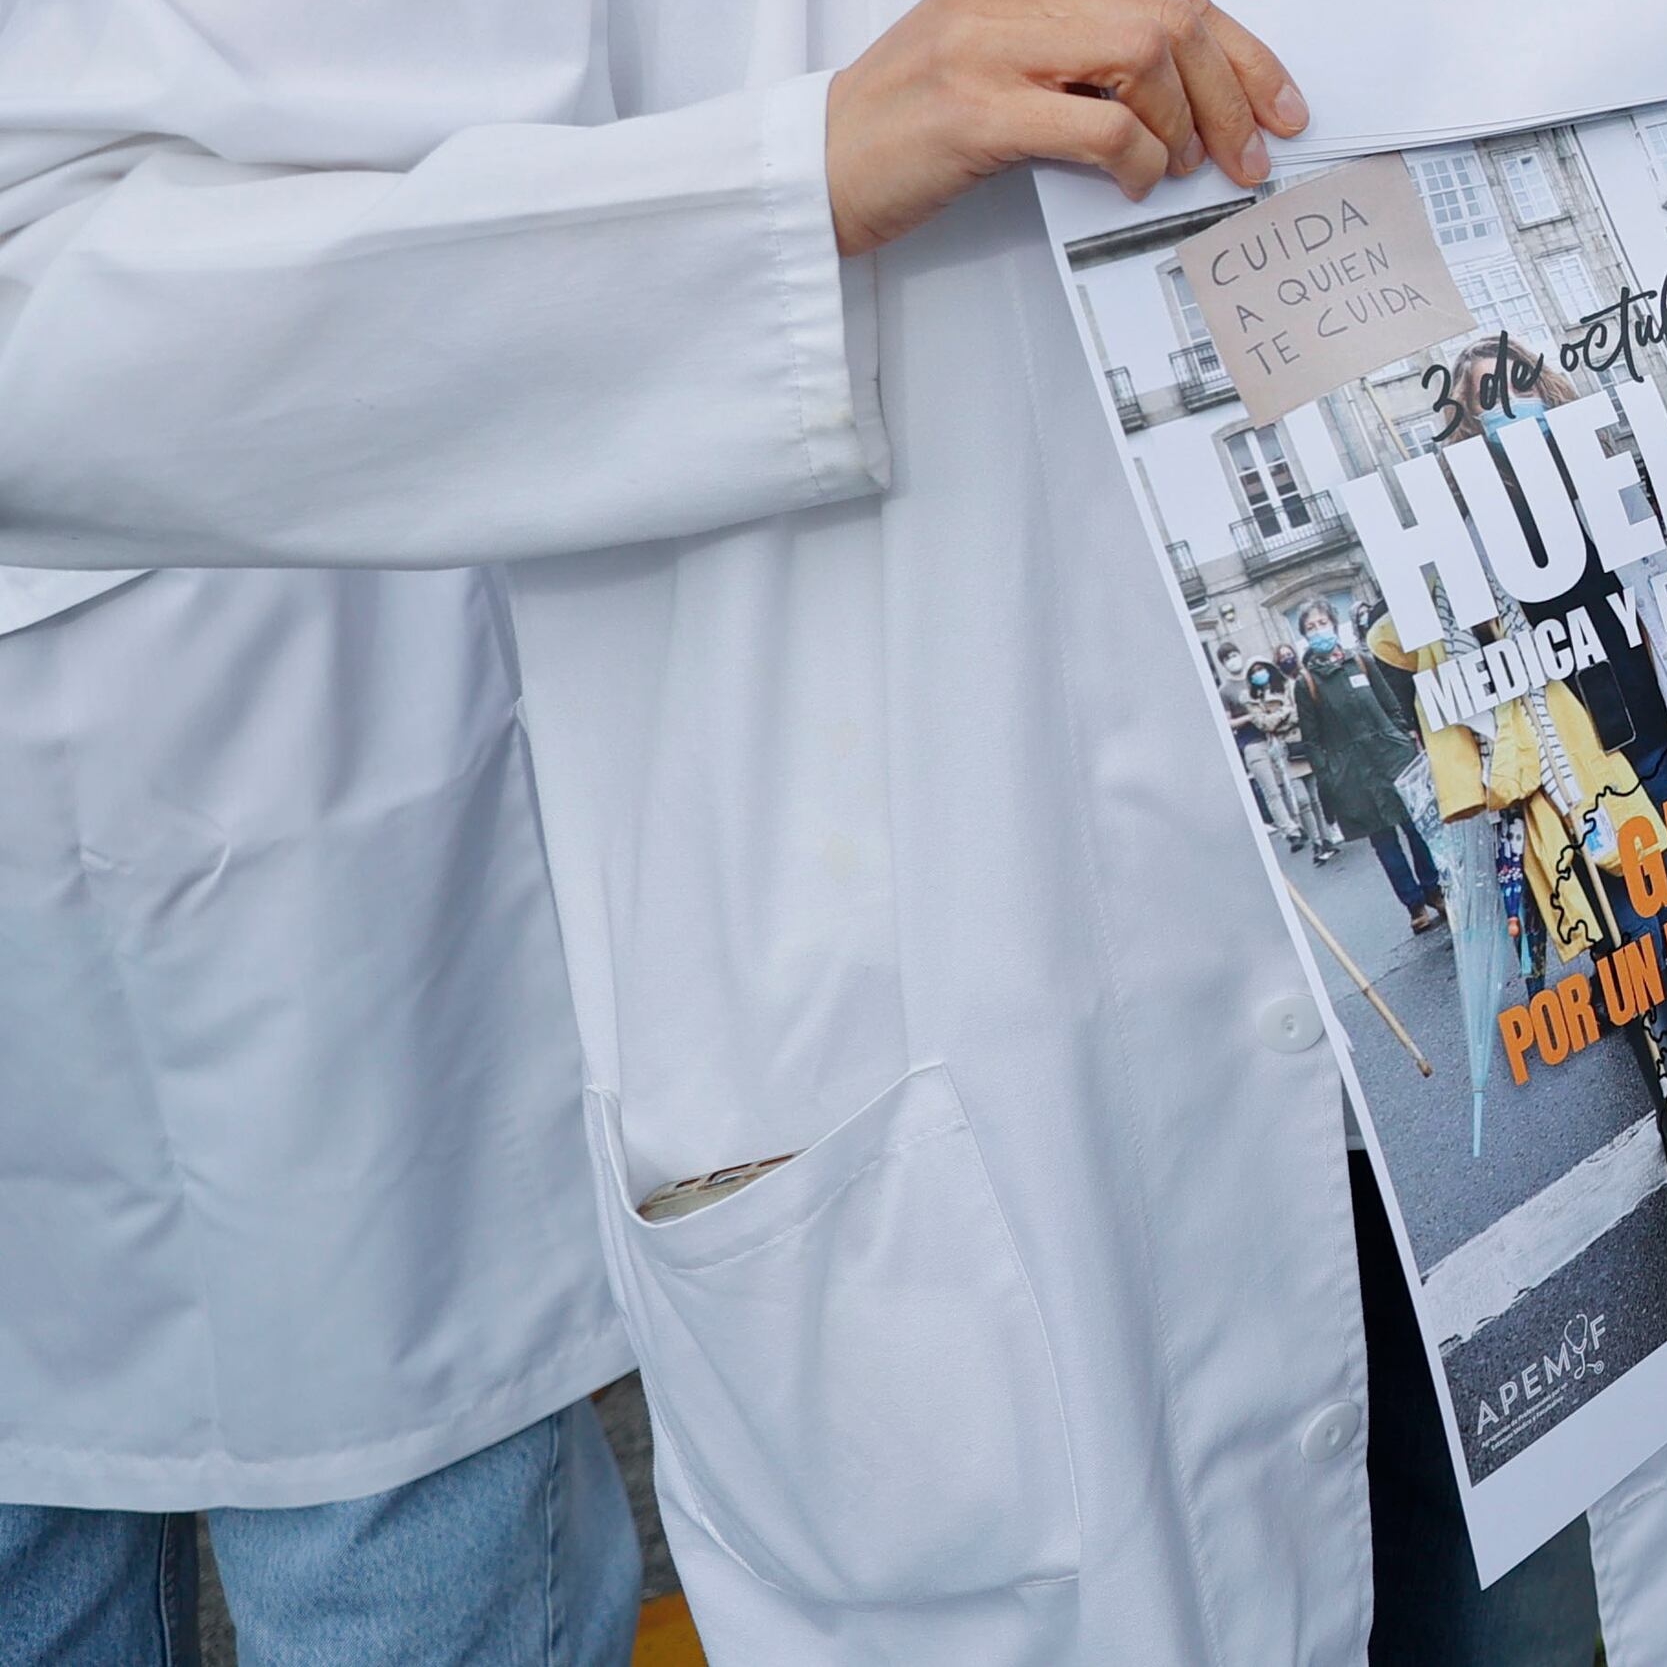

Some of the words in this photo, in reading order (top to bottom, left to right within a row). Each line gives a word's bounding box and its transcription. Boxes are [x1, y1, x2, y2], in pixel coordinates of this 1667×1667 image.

[1211, 198, 1369, 287] CUIDA
[1235, 304, 1264, 334] A
[1277, 242, 1390, 306] QUIEN
[1245, 330, 1301, 375] TE
[1316, 282, 1432, 339] CUIDA
[1421, 363, 1465, 443] 3
[1479, 329, 1545, 420] de
[1411, 604, 1608, 734] MEDICA
[1605, 586, 1643, 649] Y
[1496, 971, 1601, 1087] POR
[1595, 931, 1666, 1028] UN
